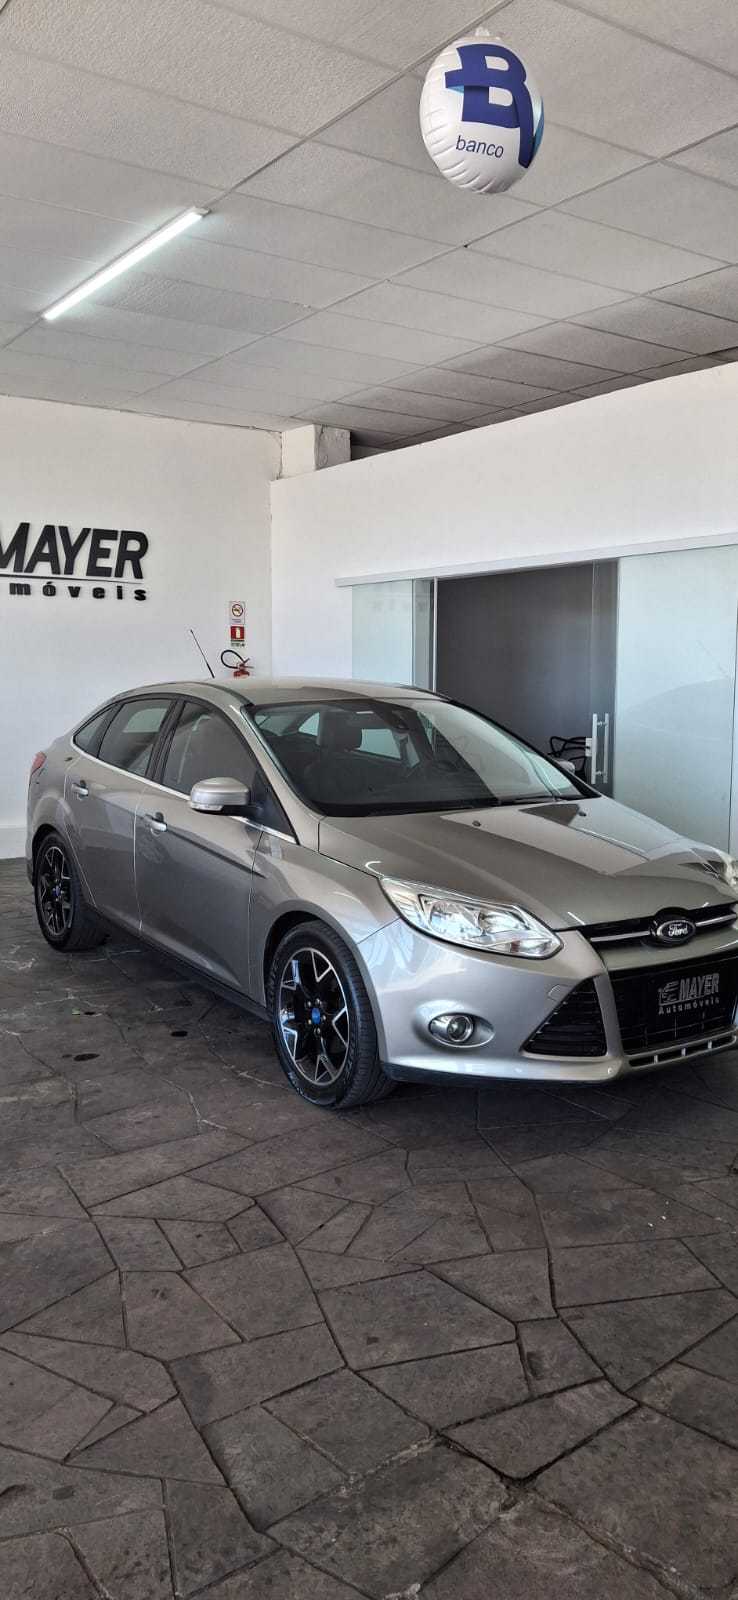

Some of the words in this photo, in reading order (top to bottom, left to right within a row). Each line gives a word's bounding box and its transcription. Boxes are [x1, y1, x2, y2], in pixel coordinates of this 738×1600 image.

[456, 135, 504, 158] banco
[668, 923, 688, 937] Ford
[679, 973, 720, 1001] MAYER
